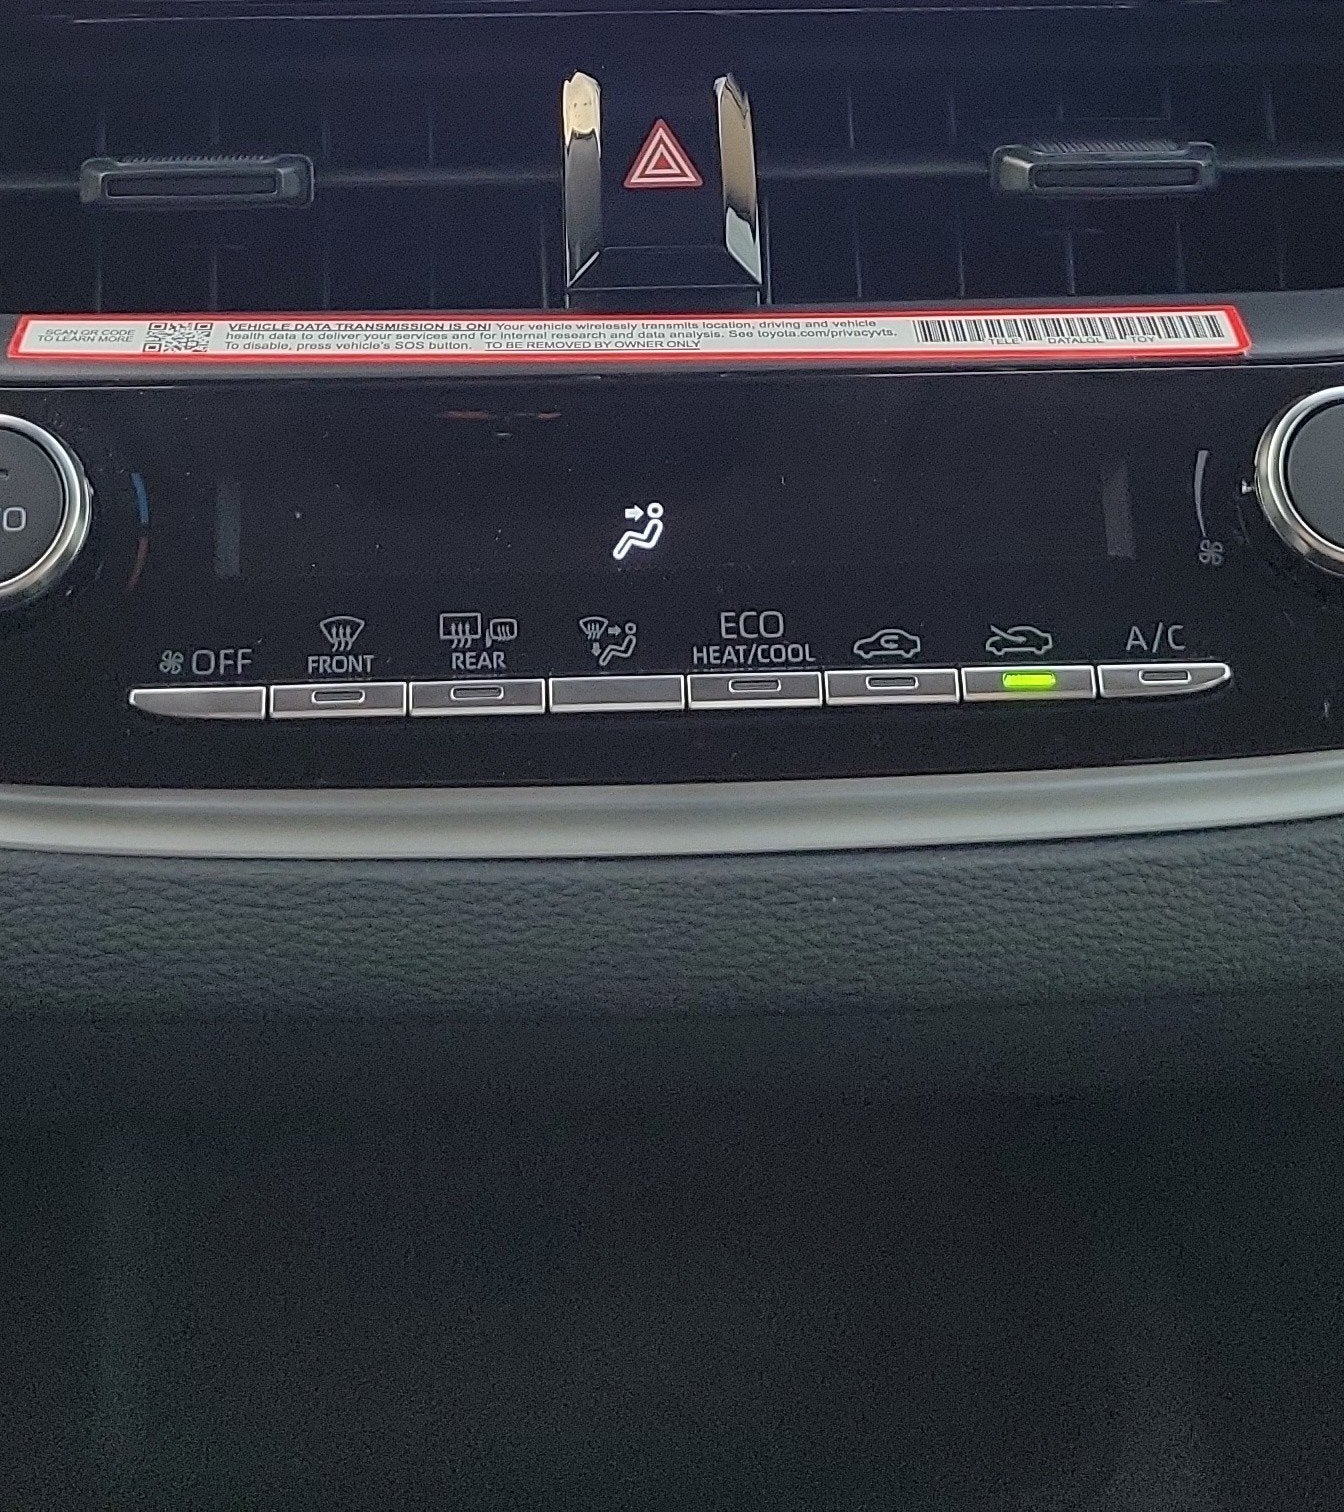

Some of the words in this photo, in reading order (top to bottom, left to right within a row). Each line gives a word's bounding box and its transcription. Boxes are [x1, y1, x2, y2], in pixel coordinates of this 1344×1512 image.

[228, 323, 290, 331] VEHICLE
[294, 323, 332, 331] DATA
[335, 323, 444, 331] TRANSMISSION
[449, 323, 462, 331] IS
[495, 323, 525, 331] Your
[575, 322, 638, 331] wirelessly
[702, 321, 756, 329] location,
[759, 320, 801, 330] driving
[805, 320, 828, 328] and
[832, 320, 877, 328] vehicle
[225, 332, 265, 340] health
[268, 332, 297, 340] data
[301, 332, 314, 340] to
[317, 332, 362, 340] deliver
[363, 333, 392, 342] your
[395, 332, 448, 340] services
[452, 332, 476, 340] and
[479, 332, 497, 340] for
[500, 332, 547, 340] internal
[551, 331, 607, 339] research
[610, 331, 634, 339] and
[669, 330, 725, 340] analysis.
[728, 330, 754, 338] See
[225, 341, 239, 350] To
[243, 342, 292, 351] disable,
[296, 343, 332, 351] press
[335, 342, 391, 350] vehicle's
[394, 341, 425, 350] SOS
[428, 341, 472, 350] button.
[484, 341, 503, 349] TO
[506, 341, 524, 349] BE
[526, 341, 592, 349] REMOVED
[594, 341, 612, 349] BY
[614, 340, 664, 348] OWNER
[666, 340, 701, 348] ONLY
[720, 611, 785, 639] ECO
[1126, 621, 1186, 652] A/C
[191, 648, 253, 675] OFF
[307, 654, 375, 674] FRONT
[451, 651, 507, 670] REAR
[692, 644, 816, 665] HEAT/COOL
